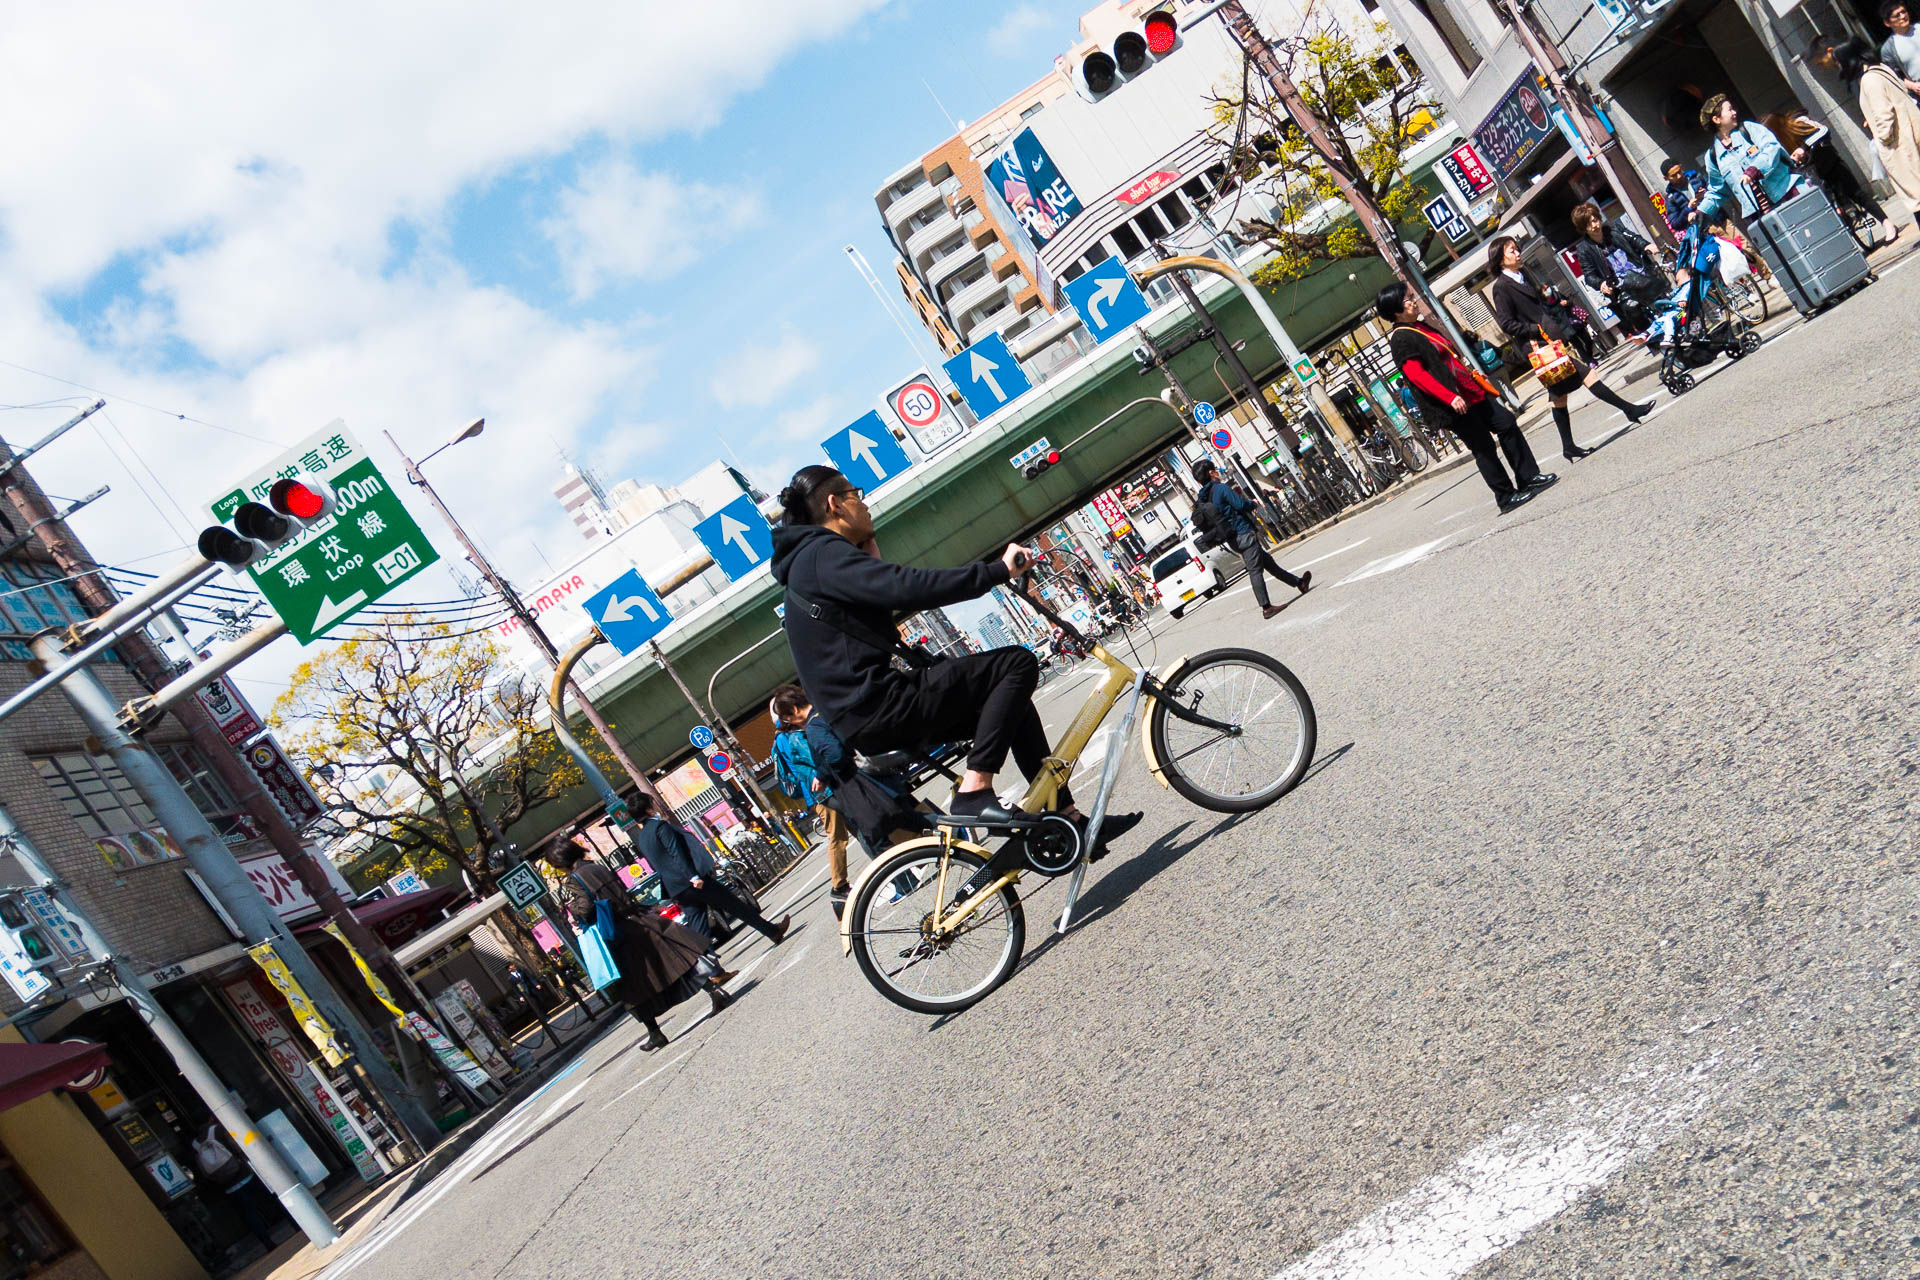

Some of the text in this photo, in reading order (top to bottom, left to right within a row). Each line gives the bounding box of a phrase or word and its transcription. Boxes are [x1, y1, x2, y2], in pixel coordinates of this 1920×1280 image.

[1480, 98, 1519, 147] インターネット
[1489, 117, 1530, 165] コミックカフェ
[1457, 147, 1483, 180] 営業中
[1129, 182, 1148, 200] shot
[1145, 174, 1162, 190] bar
[1444, 157, 1478, 200] ネットカフェ
[1039, 210, 1071, 239] GINZA
[905, 393, 932, 417] 50
[218, 495, 240, 512] Loop
[325, 553, 365, 582] Loop
[378, 544, 417, 580] 1-01
[395, 874, 417, 892] 近鉄
[504, 870, 529, 889] TAXI
[239, 1000, 268, 1018] Tax
[252, 1016, 280, 1039] free
